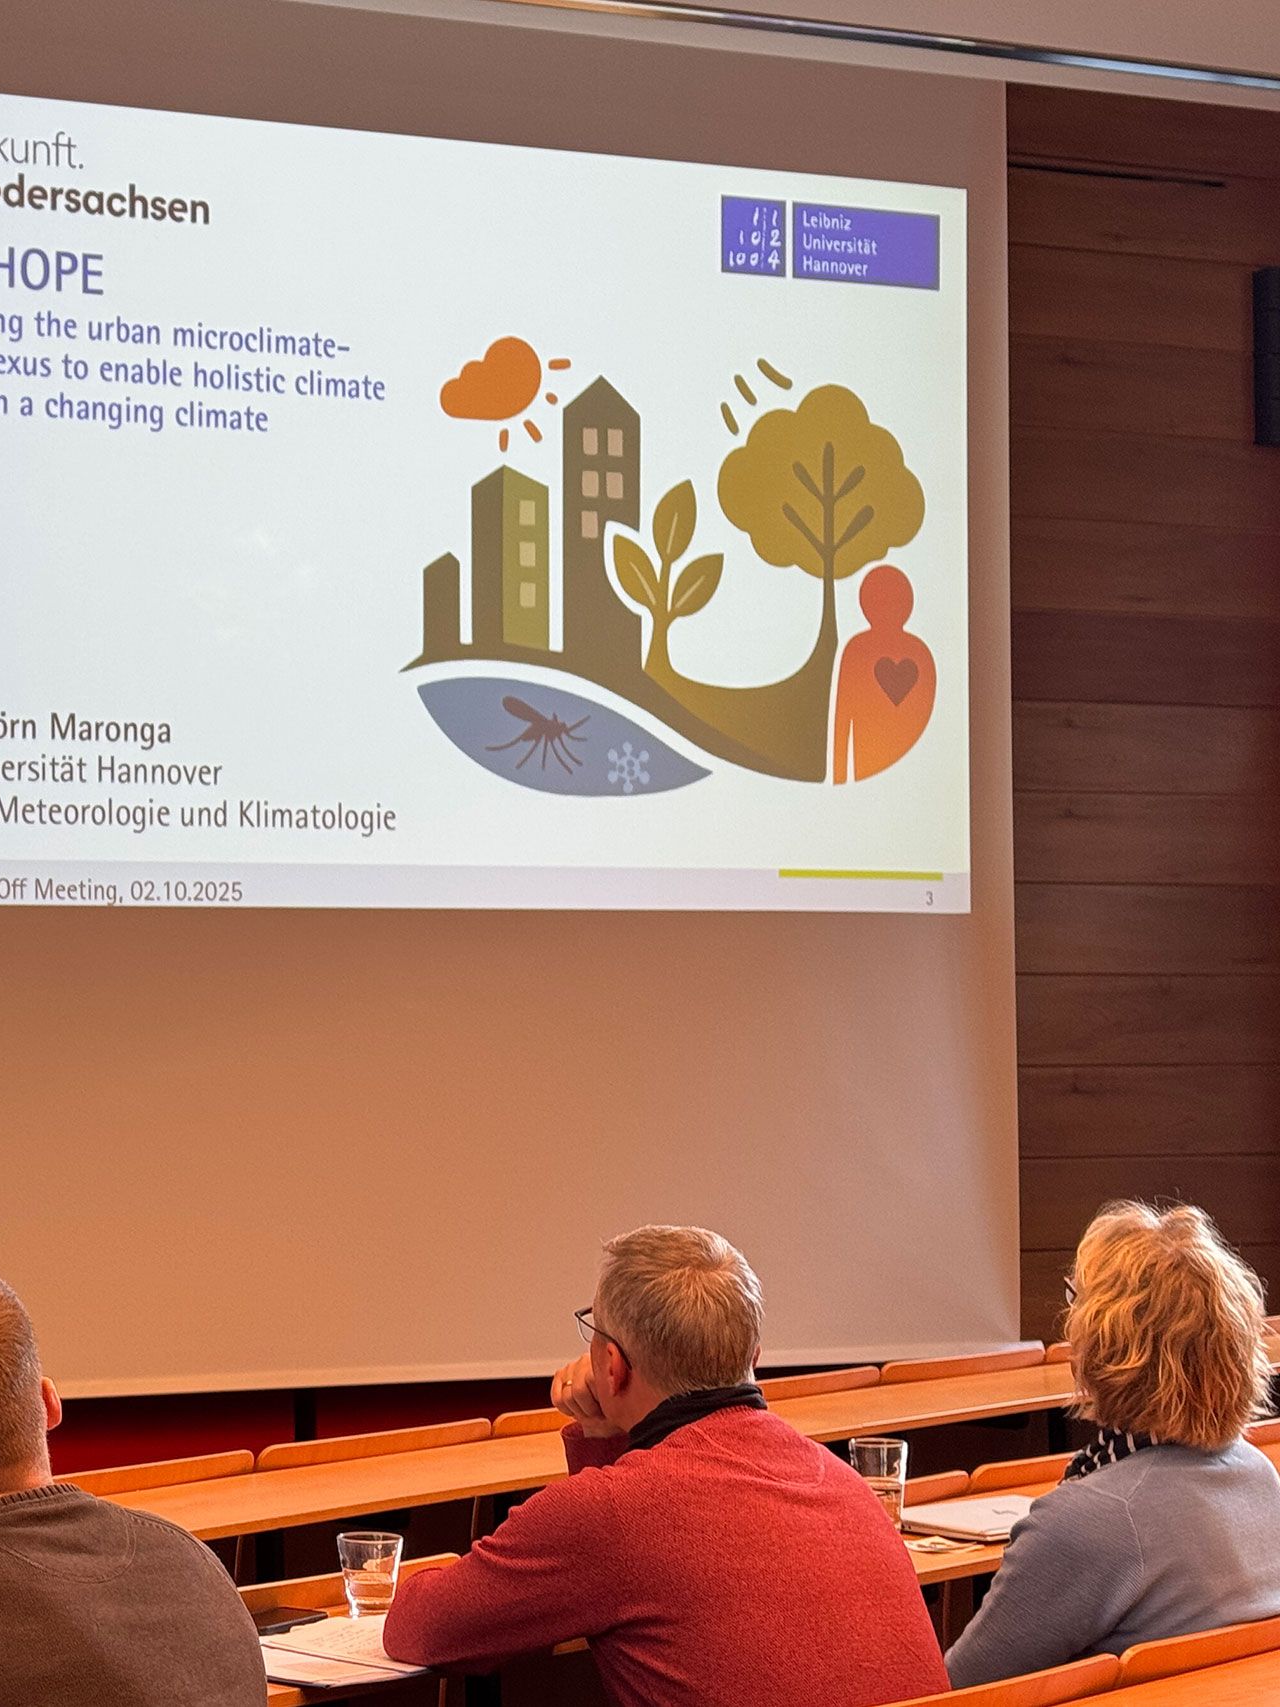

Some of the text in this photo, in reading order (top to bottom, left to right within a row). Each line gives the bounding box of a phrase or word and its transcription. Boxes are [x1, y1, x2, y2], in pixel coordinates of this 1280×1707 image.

[803, 210, 852, 232] Leibniz
[803, 233, 878, 256] Universität
[803, 256, 869, 277] Hannover
[34, 310, 78, 340] the
[87, 314, 161, 346] urban
[172, 321, 352, 361] microclimate-
[61, 353, 89, 381] to
[99, 354, 183, 388] enable
[193, 360, 287, 395] holistic
[294, 369, 387, 402] climate
[19, 395, 34, 417] a
[44, 391, 164, 432] changing
[174, 400, 269, 433] climate
[50, 711, 172, 752] Maronga
[97, 754, 223, 787] Hannover
[180, 798, 229, 829] und
[239, 799, 398, 838] Klimatologie
[34, 877, 124, 908] Meeting,
[130, 880, 244, 902] 02.10.2025
[925, 890, 934, 906] 3
